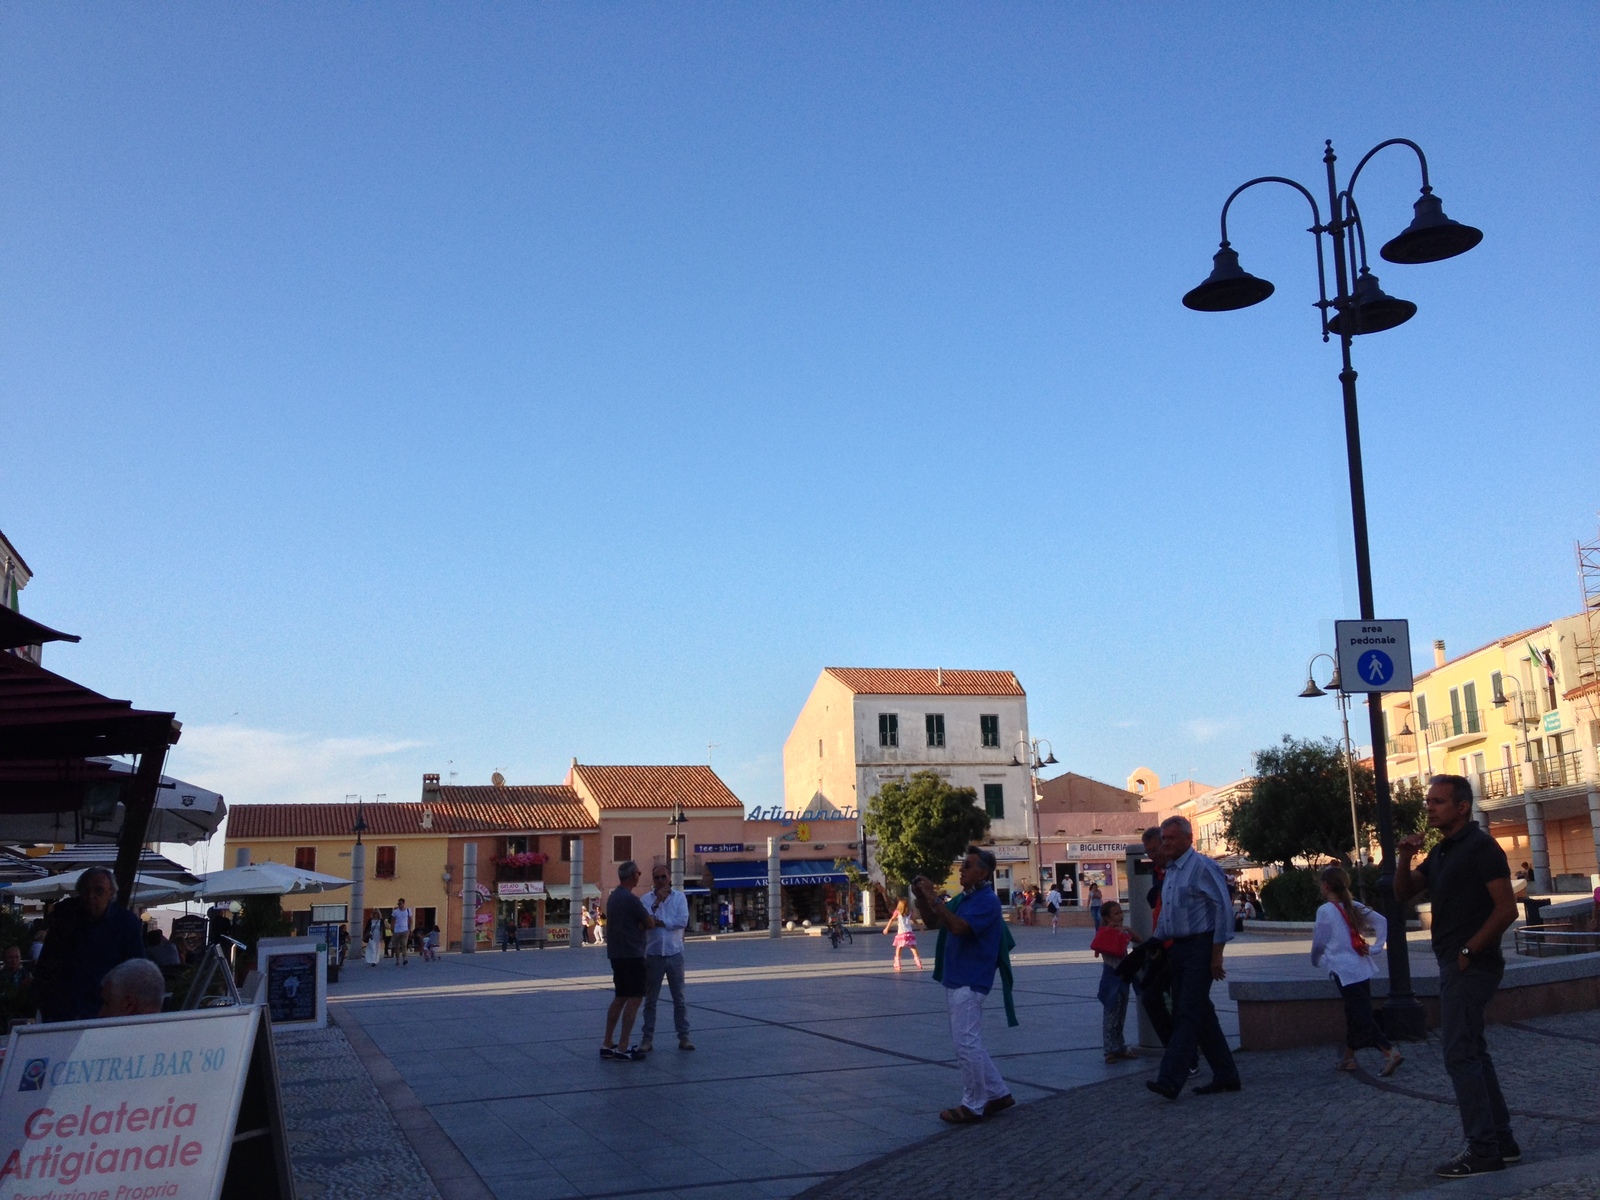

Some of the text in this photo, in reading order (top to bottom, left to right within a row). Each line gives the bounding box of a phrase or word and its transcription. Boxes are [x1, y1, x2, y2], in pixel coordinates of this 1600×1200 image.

[1350, 636, 1396, 645] pedonale
[747, 805, 860, 826] Artigianato
[699, 844, 739, 852] tee-shirt
[755, 877, 832, 886] ARGIANATO
[50, 1053, 147, 1086] CENTRAL
[150, 1050, 194, 1077] BAR
[24, 1097, 198, 1140] Gelateria
[0, 1135, 203, 1185] Artigianale
[115, 1181, 179, 1200] Propria
